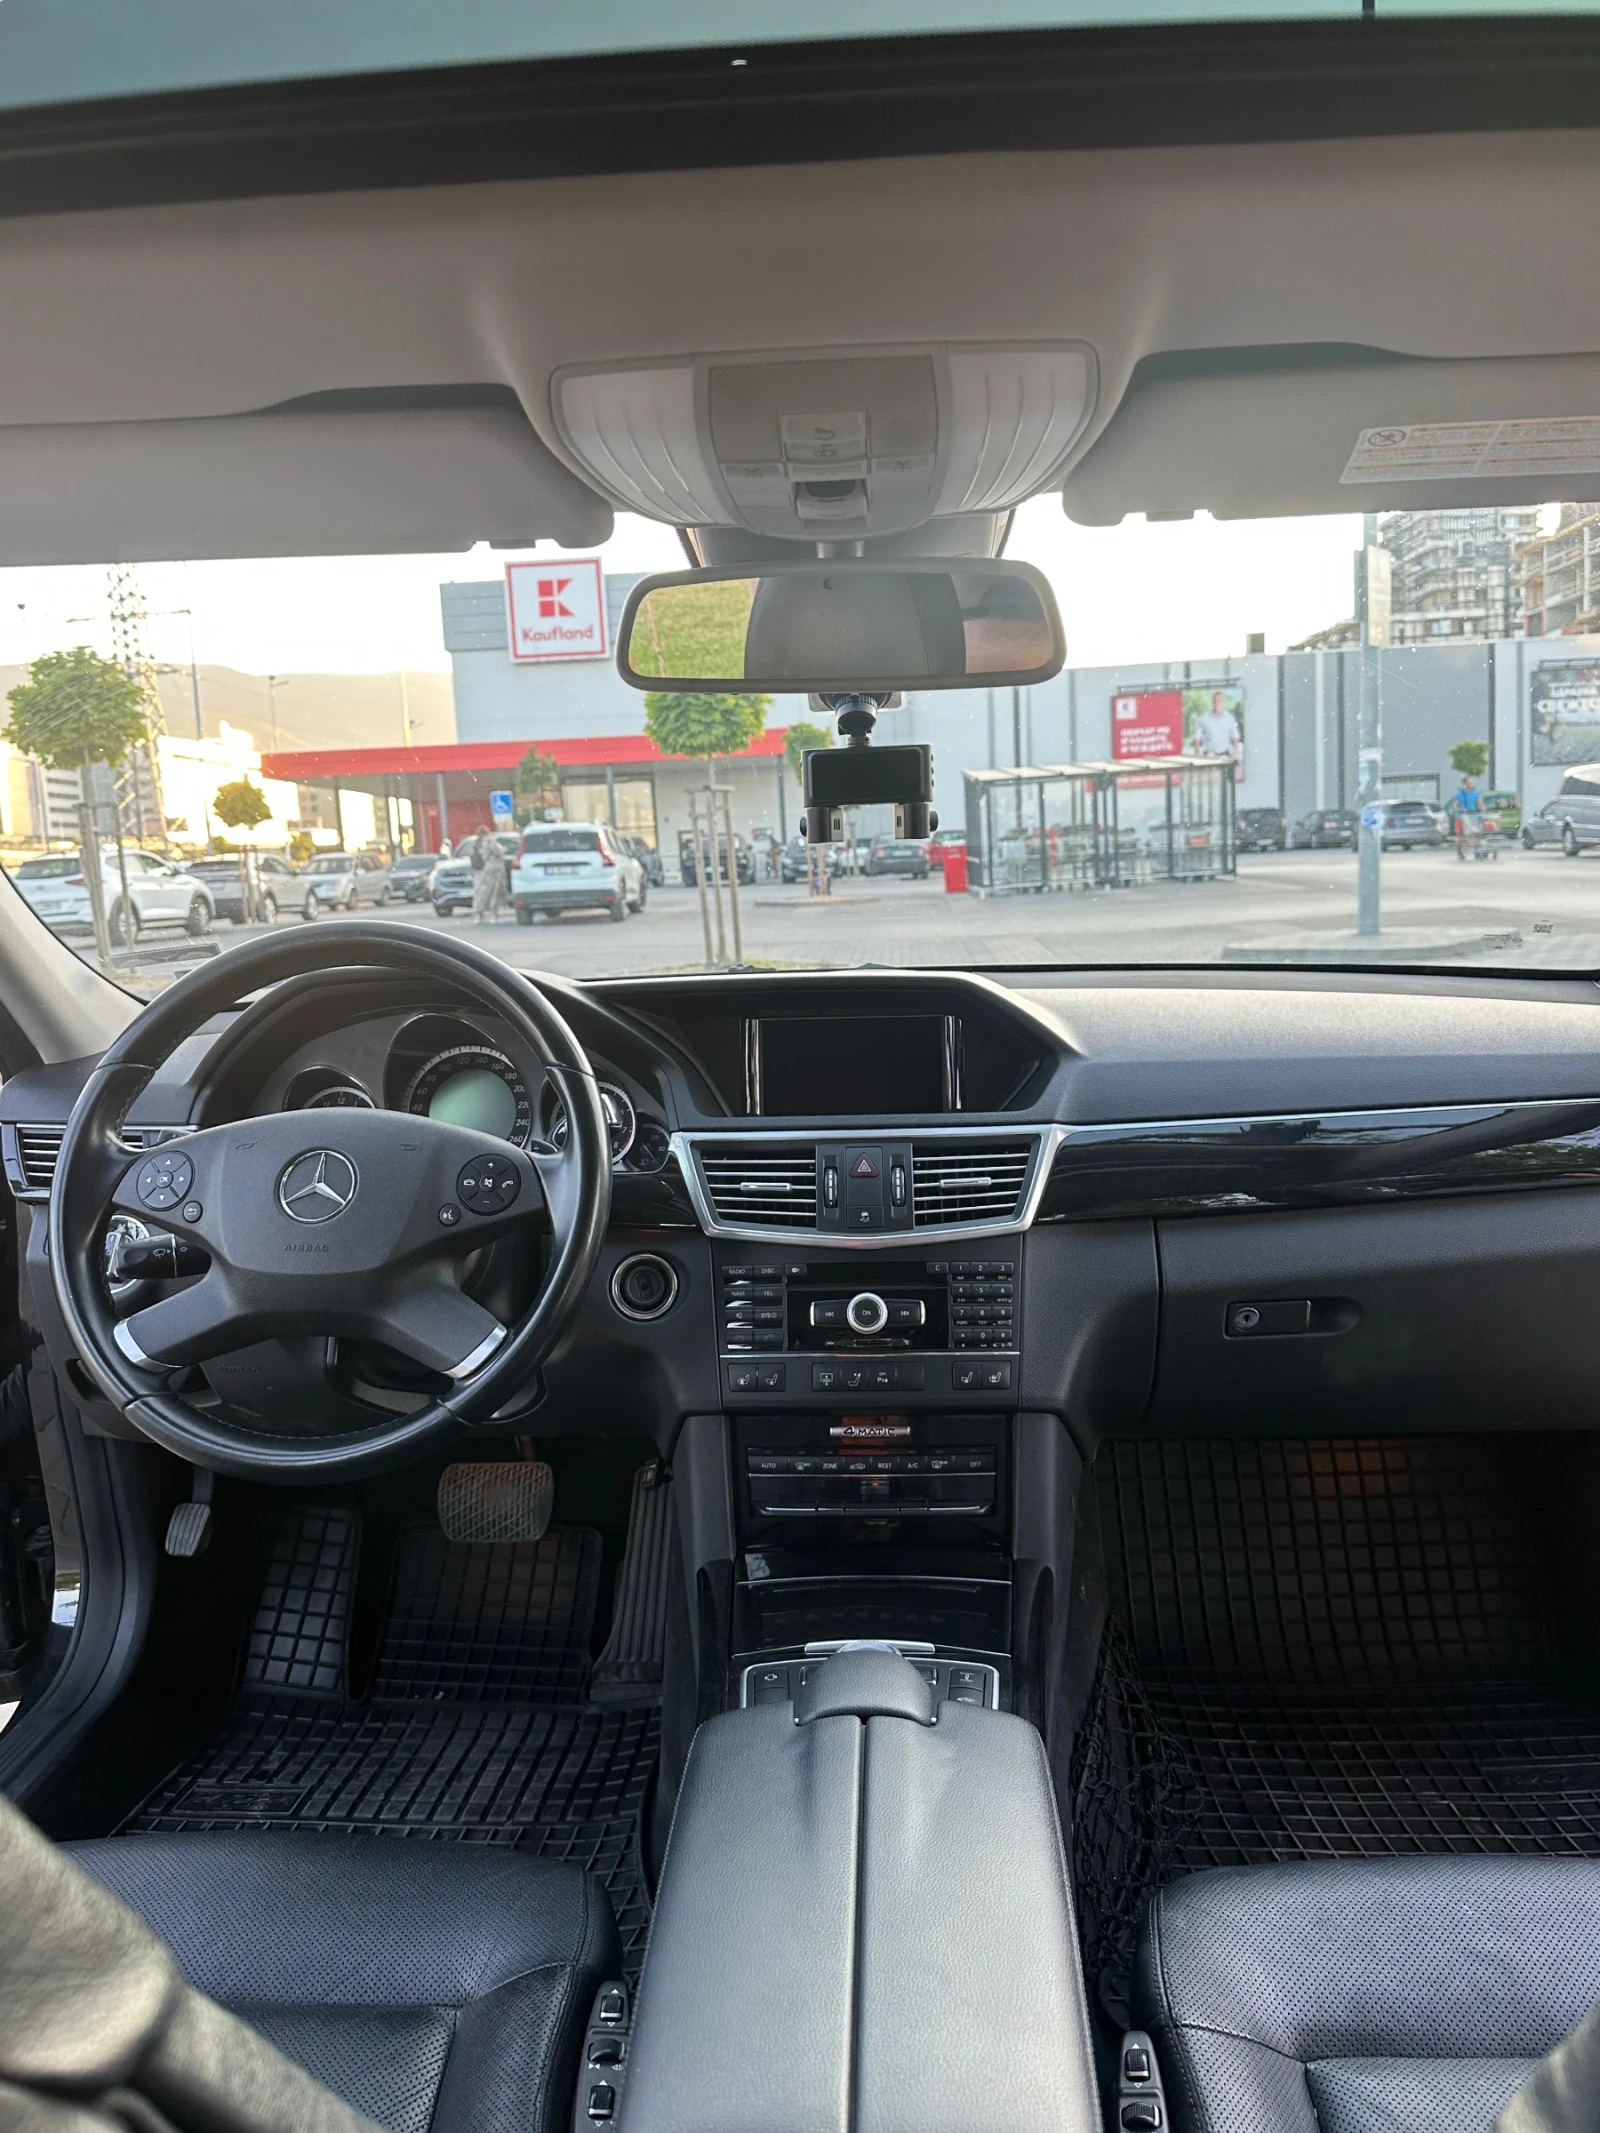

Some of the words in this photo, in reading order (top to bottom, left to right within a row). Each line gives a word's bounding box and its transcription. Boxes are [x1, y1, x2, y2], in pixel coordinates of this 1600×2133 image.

[522, 624, 594, 642] Kaufland
[426, 1074, 437, 1082] 80
[417, 1087, 428, 1095] 60
[338, 1097, 346, 1105] 12
[509, 1135, 523, 1143] 260
[284, 1244, 329, 1252] AIRBAG
[842, 1425, 897, 1437] 4MATIC
